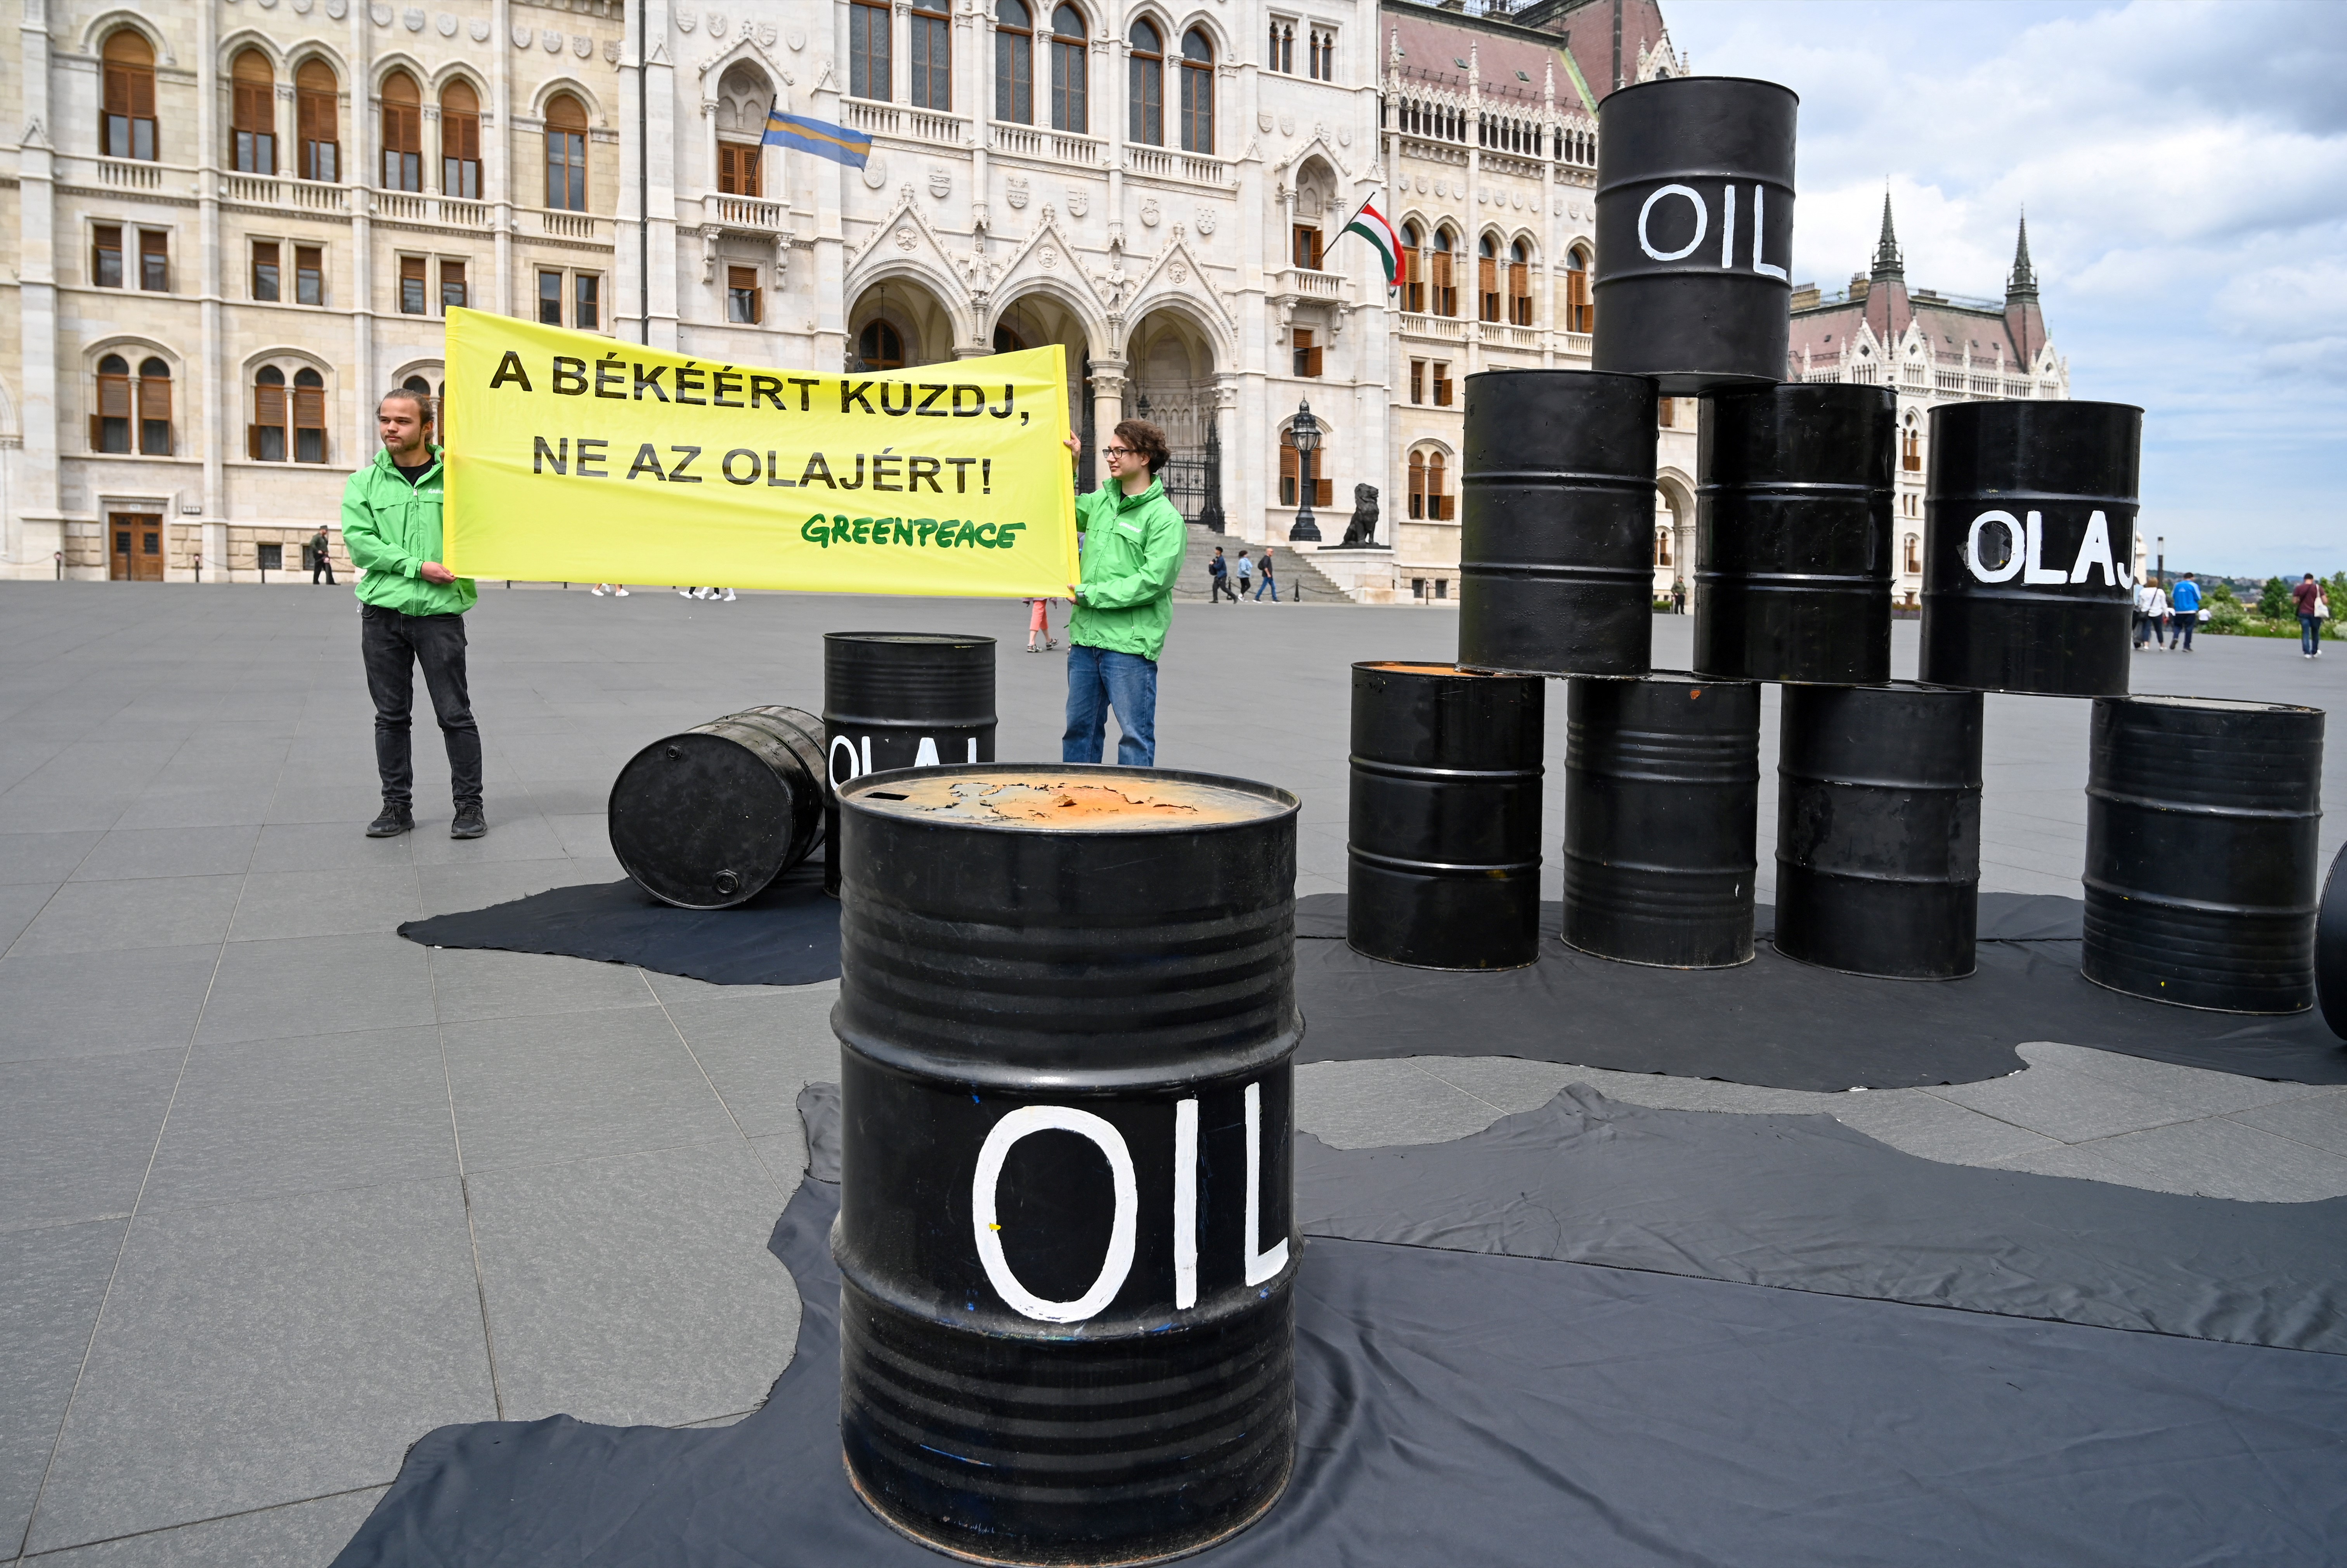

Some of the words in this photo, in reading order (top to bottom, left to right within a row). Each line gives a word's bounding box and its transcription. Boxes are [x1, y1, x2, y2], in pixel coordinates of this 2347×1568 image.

[1638, 184, 1787, 280] OIL
[489, 350, 532, 392] A
[553, 352, 820, 411] BÉKÉÉRT
[534, 436, 608, 477] NE
[626, 443, 702, 483] AZ
[722, 447, 991, 494] OLAJÉRT!
[801, 513, 1026, 548] GREENPEACE
[1967, 510, 2137, 589] OLAJ
[972, 1082, 1289, 1322] OIL
